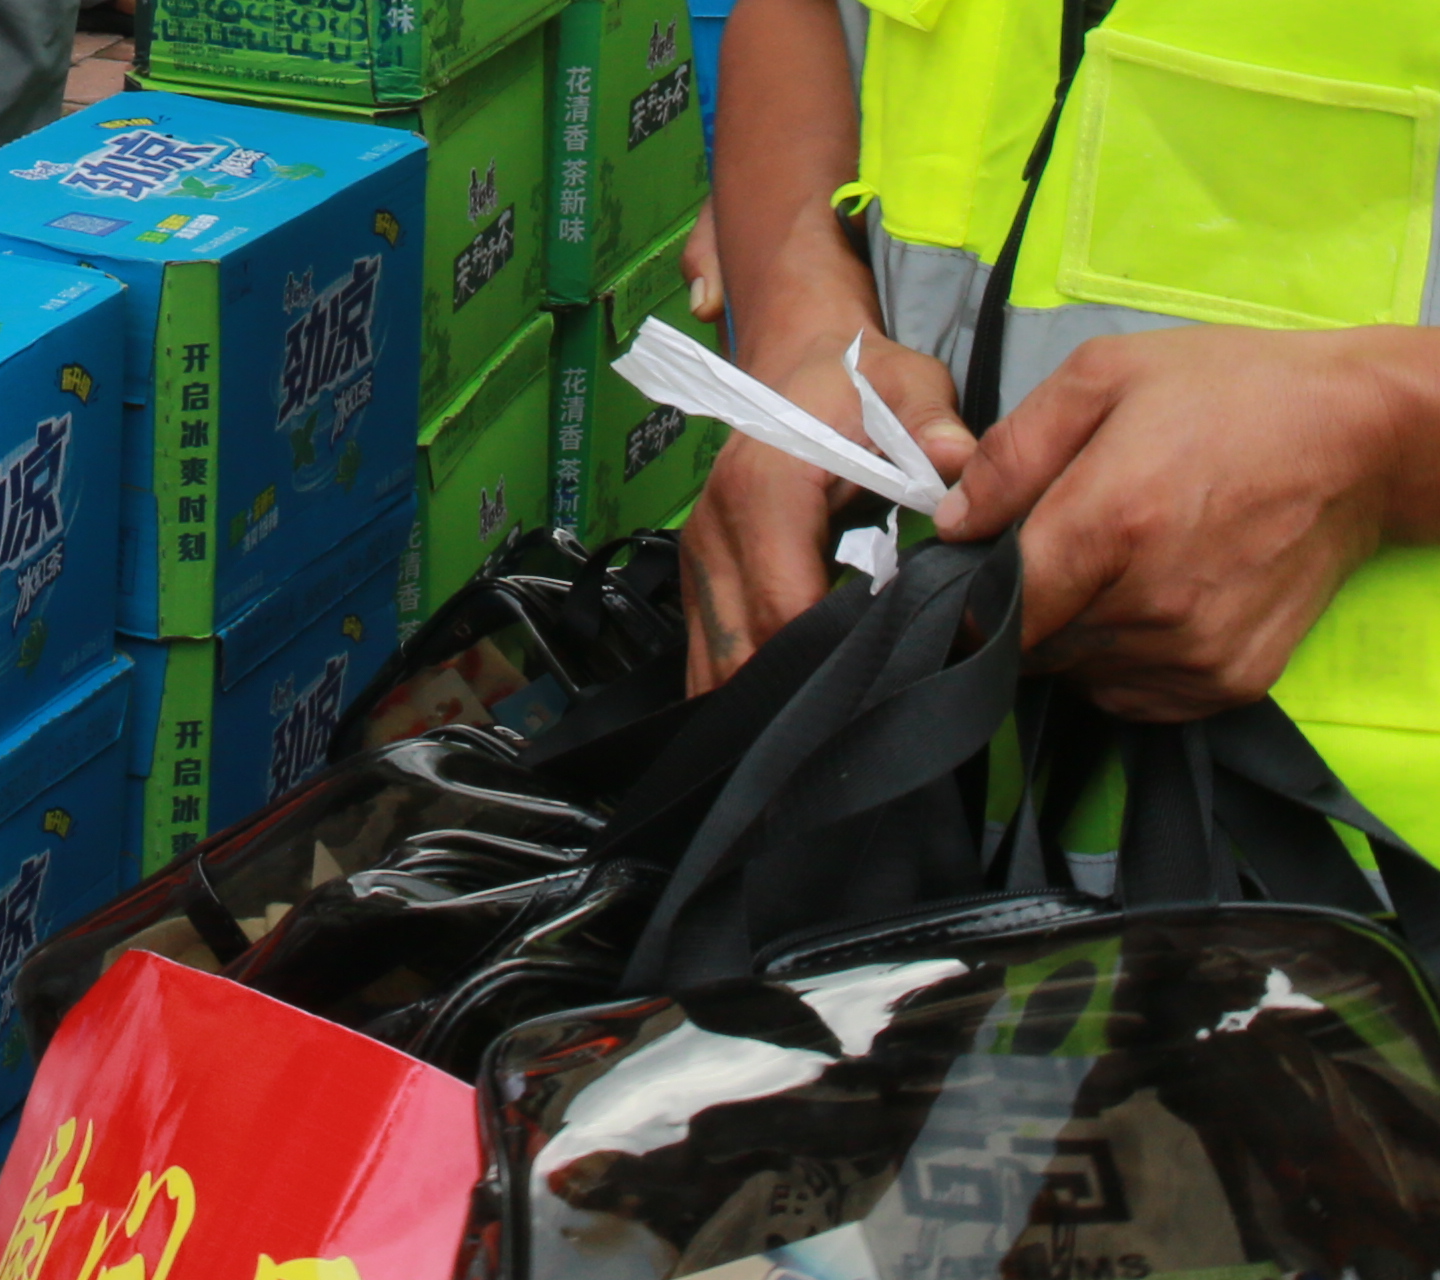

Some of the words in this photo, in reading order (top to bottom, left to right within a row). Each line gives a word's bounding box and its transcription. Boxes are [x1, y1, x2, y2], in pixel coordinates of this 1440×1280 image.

[563, 66, 591, 151] 花清香
[559, 158, 587, 243] 茶新味
[275, 253, 382, 432] 劲凉
[177, 343, 211, 562] 开启冰爽时刻
